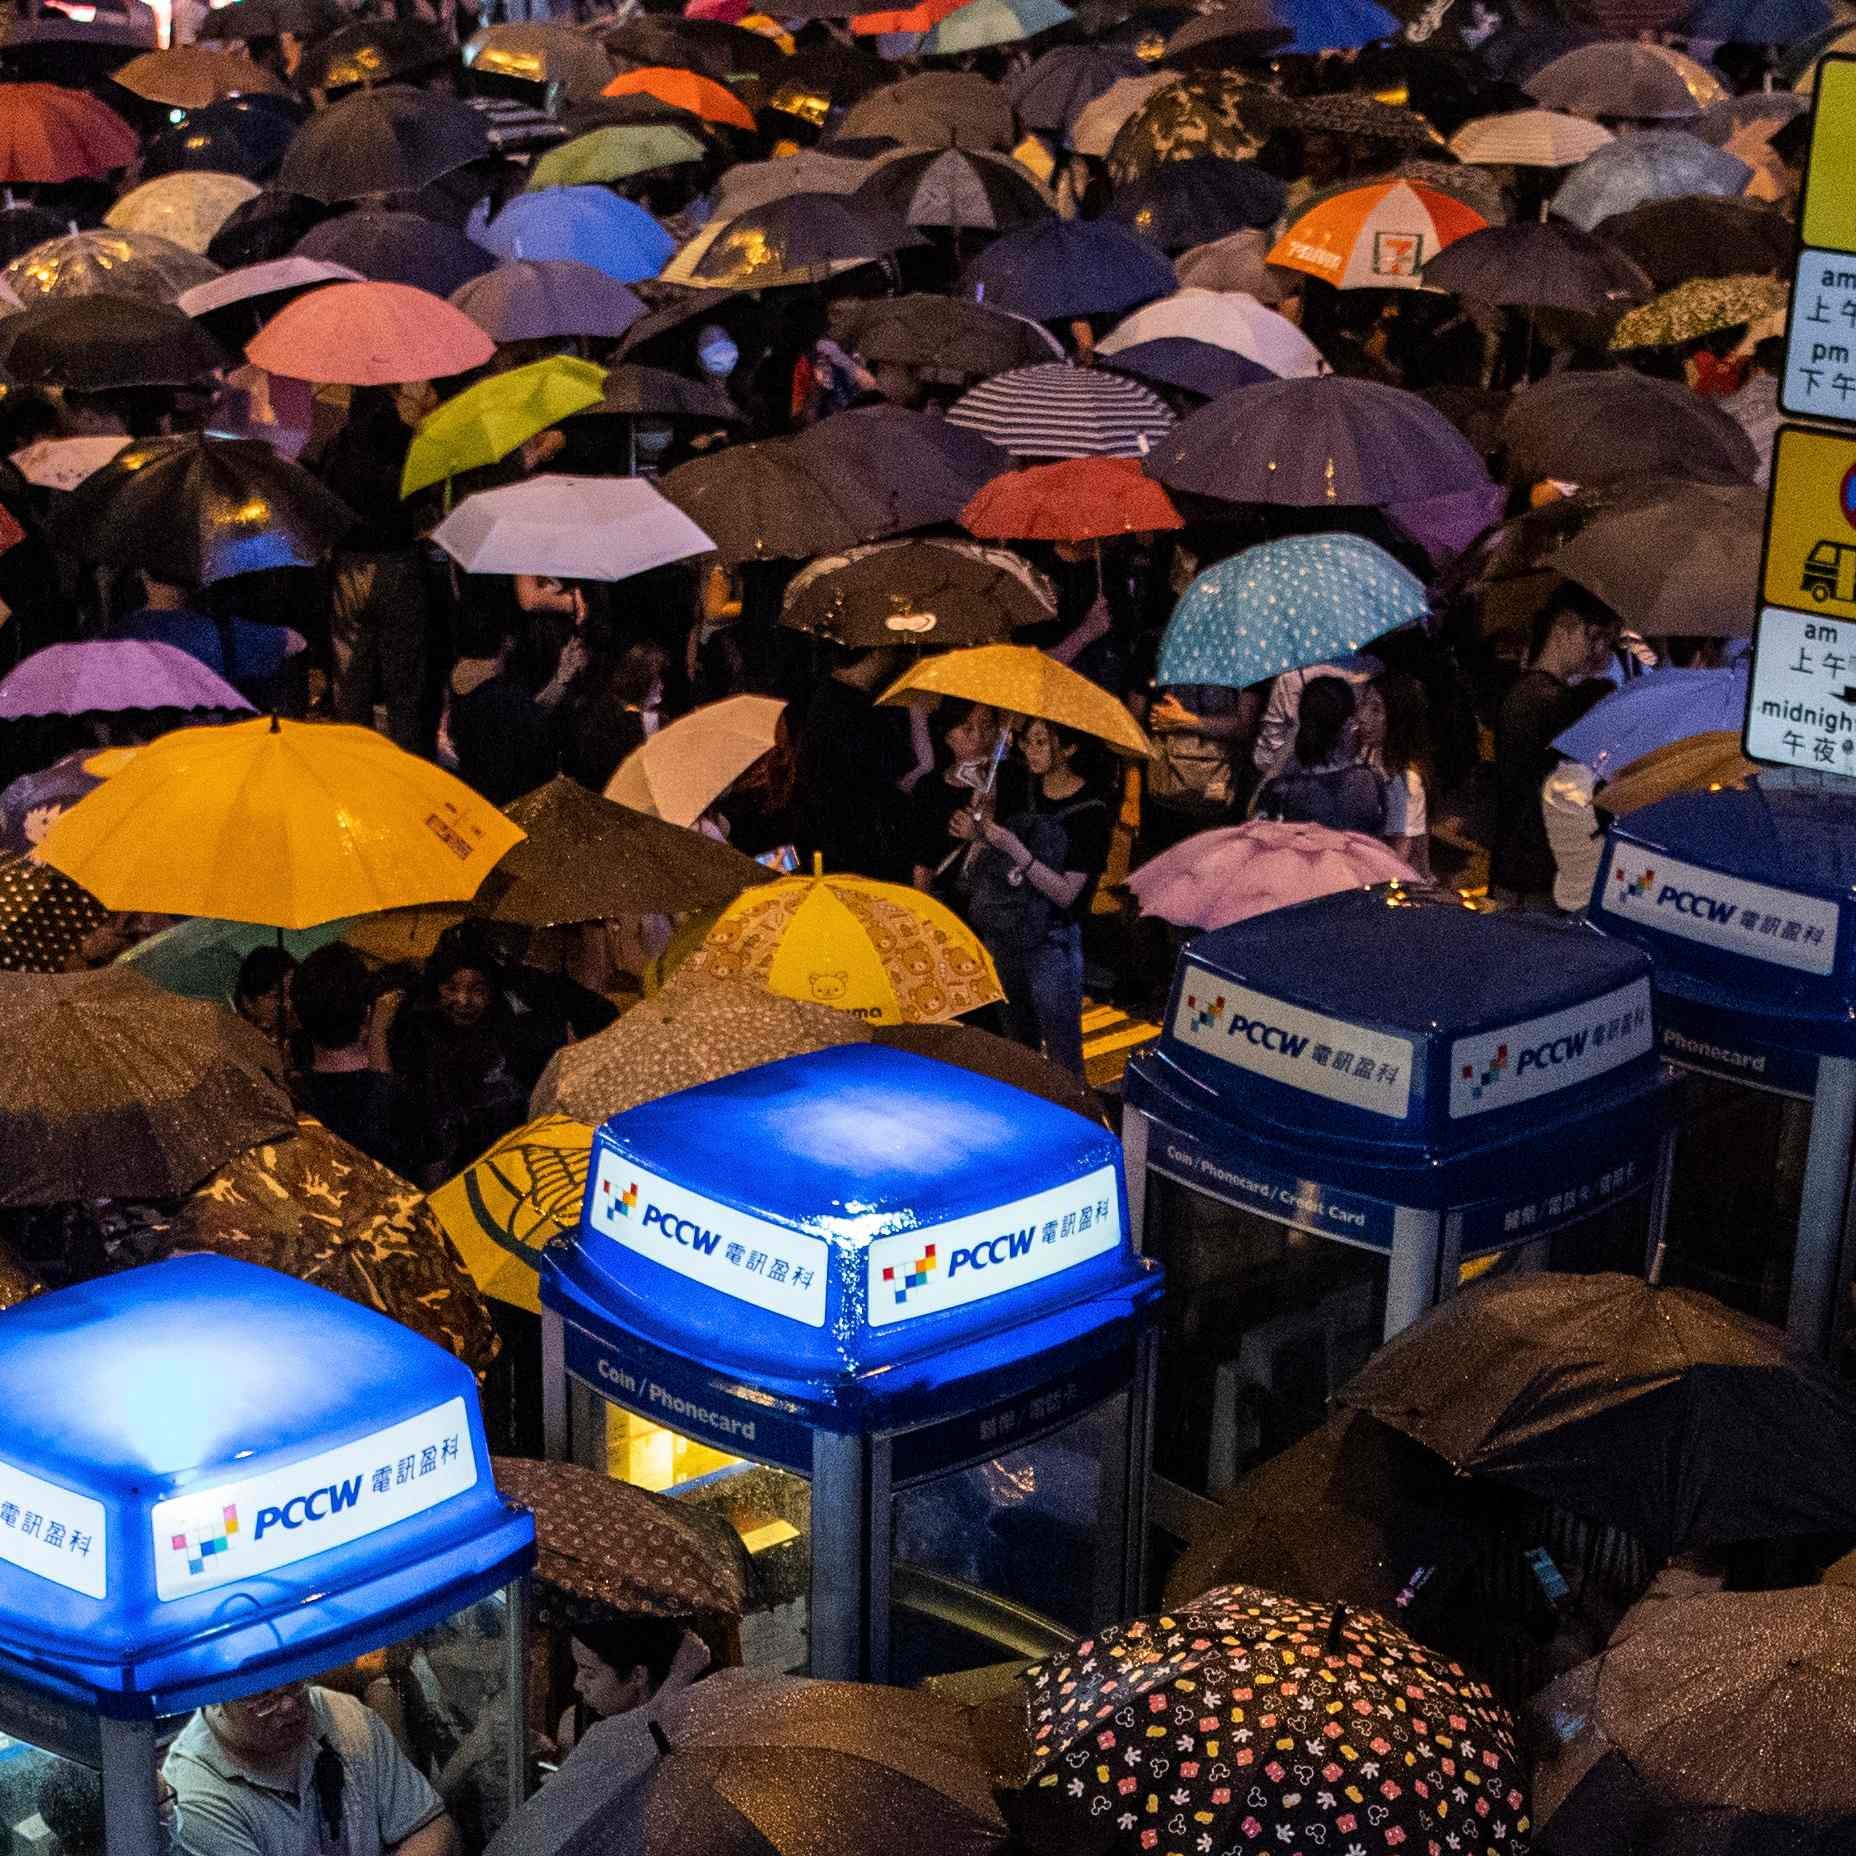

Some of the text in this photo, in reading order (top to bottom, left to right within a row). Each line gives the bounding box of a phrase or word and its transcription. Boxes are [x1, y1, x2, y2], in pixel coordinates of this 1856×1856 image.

[1811, 342, 1849, 363] pm
[1798, 367, 1856, 401] 下午
[1804, 622, 1839, 644] am
[1789, 646, 1846, 679] 上午
[1781, 729, 1836, 764] 午夜
[1656, 885, 1737, 925] PCCW
[1228, 1013, 1400, 1086] PCCW 電訊盈科
[1517, 1029, 1589, 1075] PCCW
[1661, 1029, 1767, 1074] Phonecard
[947, 1196, 1111, 1278] PCCW 電訊盈科
[1327, 1204, 1367, 1228] Card
[641, 1203, 814, 1291] PCCW 電訊盈科
[596, 1356, 636, 1392] Coin
[648, 1381, 757, 1443] Phonecard
[253, 1432, 461, 1541] PCCW 電訊盈科
